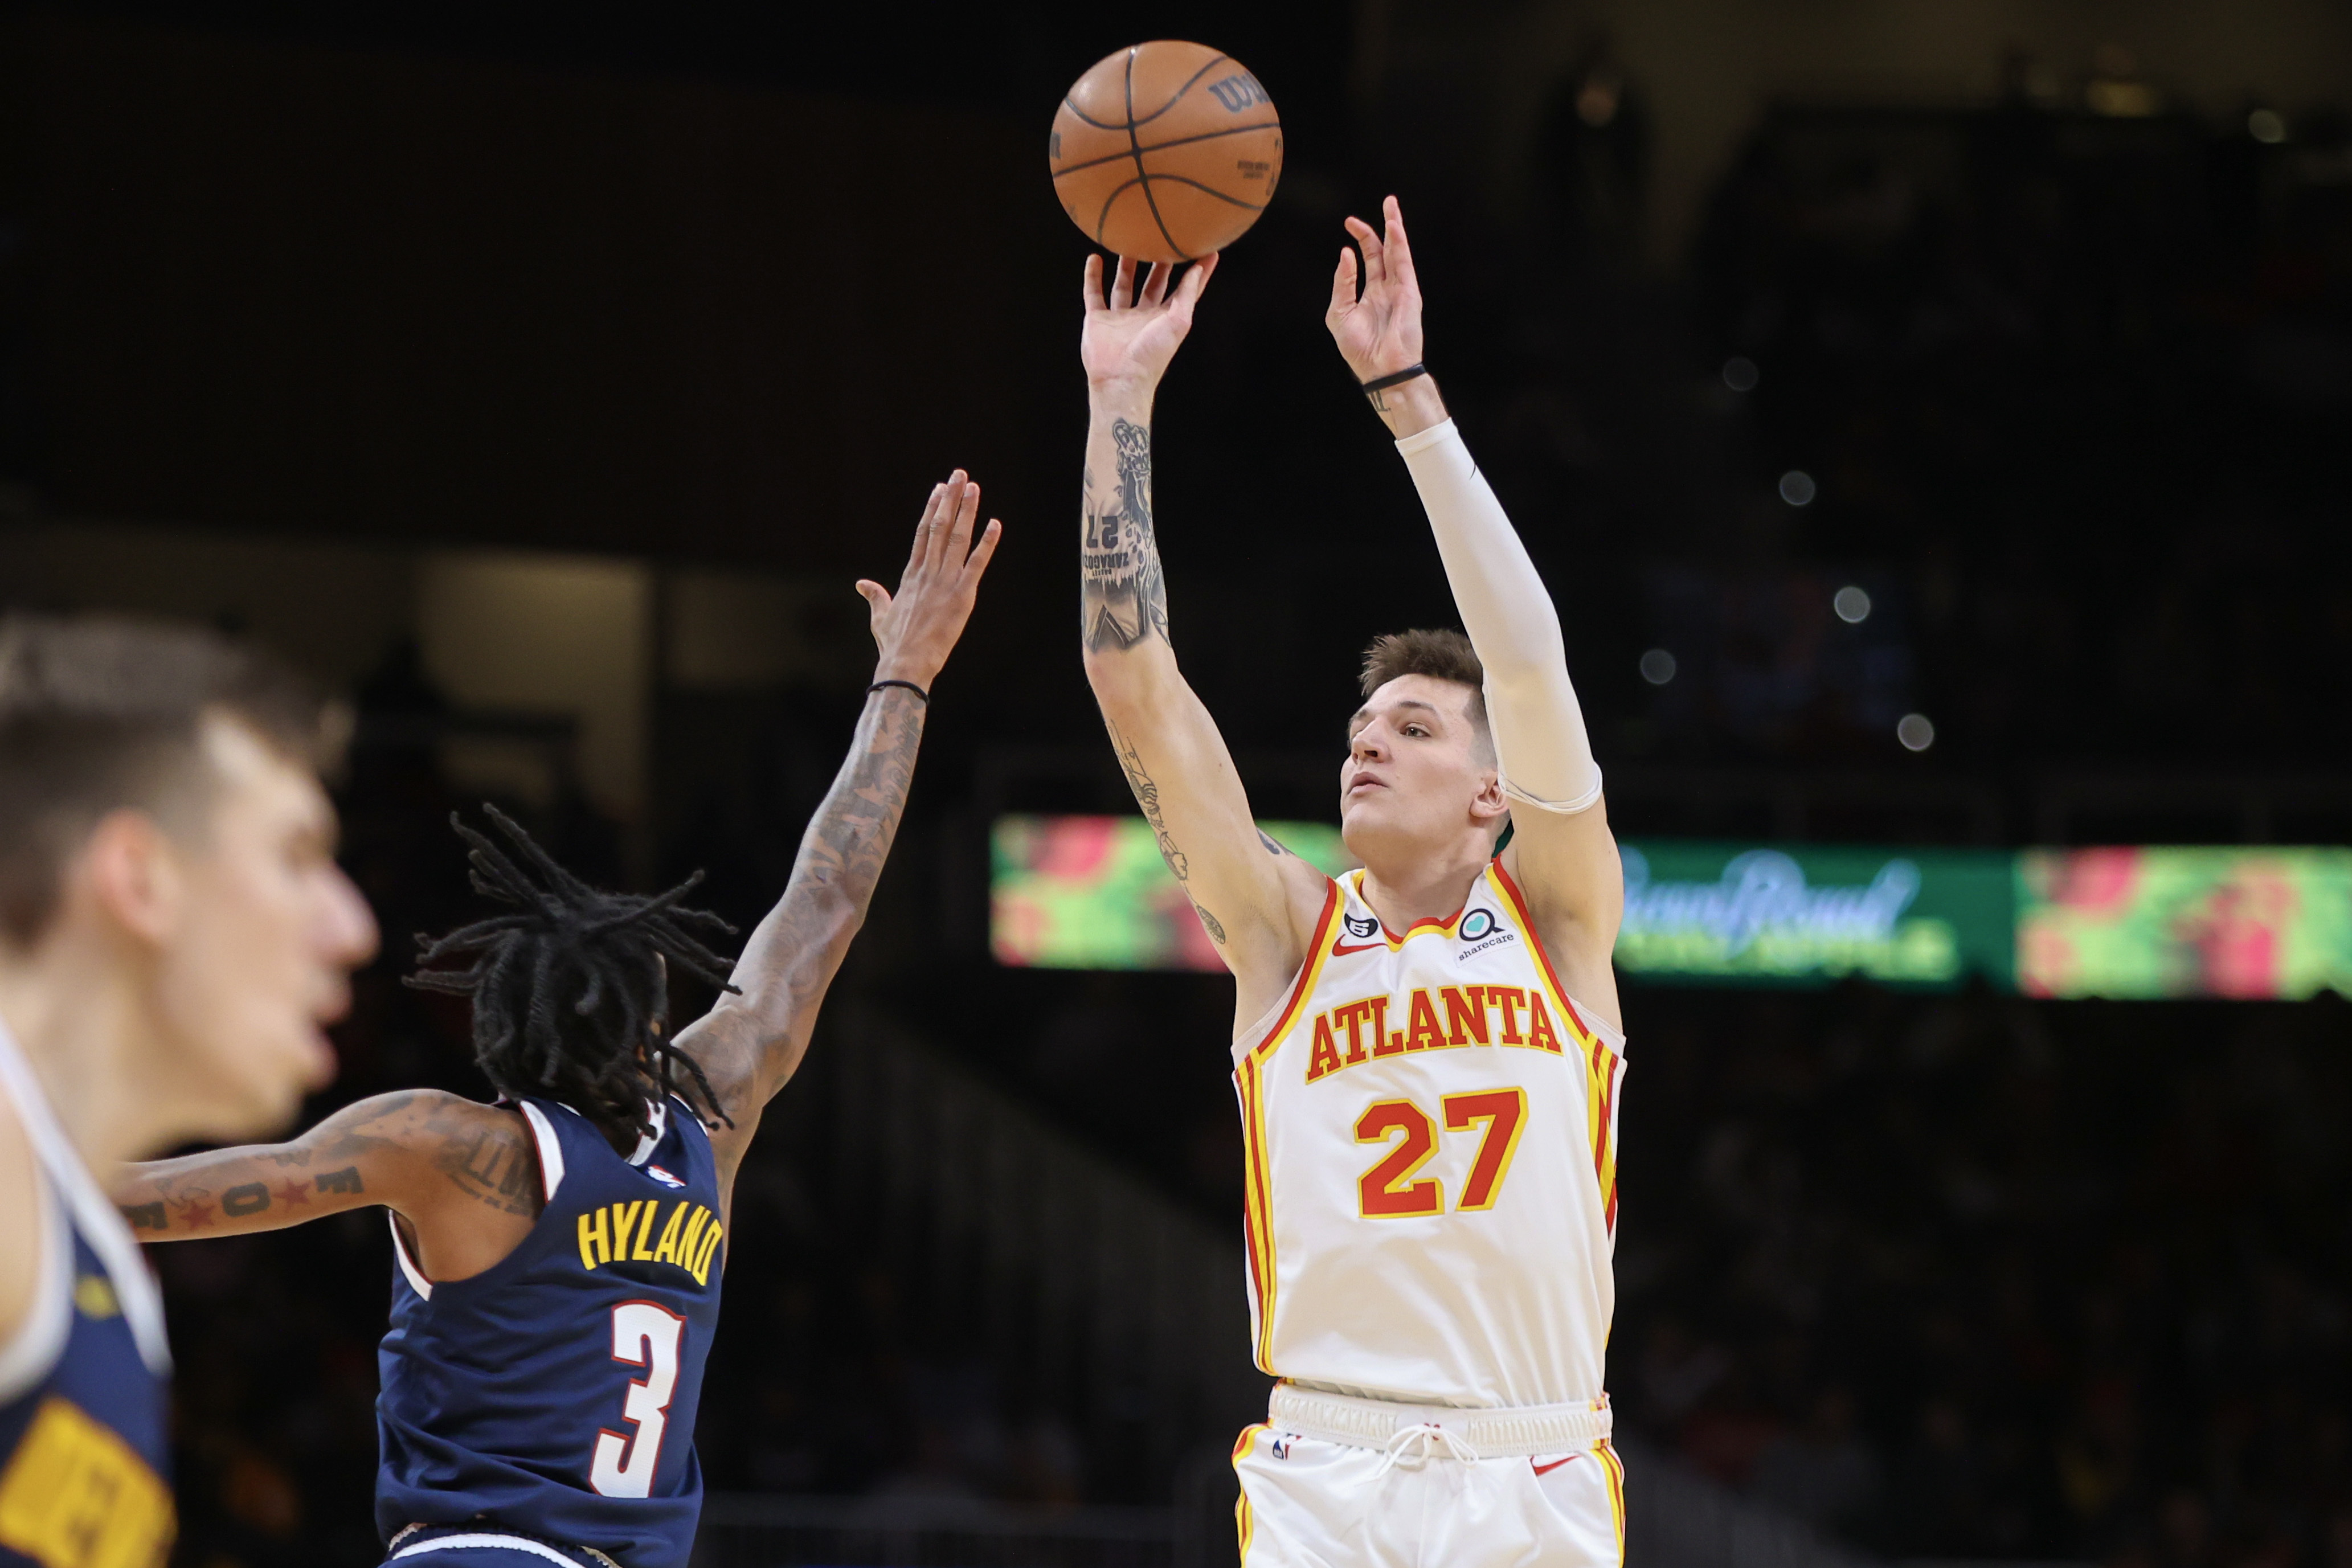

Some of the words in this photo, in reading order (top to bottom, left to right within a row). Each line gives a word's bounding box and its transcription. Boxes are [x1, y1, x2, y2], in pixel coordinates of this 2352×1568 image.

[1086, 515, 1118, 549] 27
[1459, 934, 1515, 961] sharecare
[1305, 984, 1564, 1086] ATLANTA
[1353, 1086, 1529, 1219] 27
[577, 1199, 723, 1287] HYLAND
[587, 1299, 687, 1499] 3
